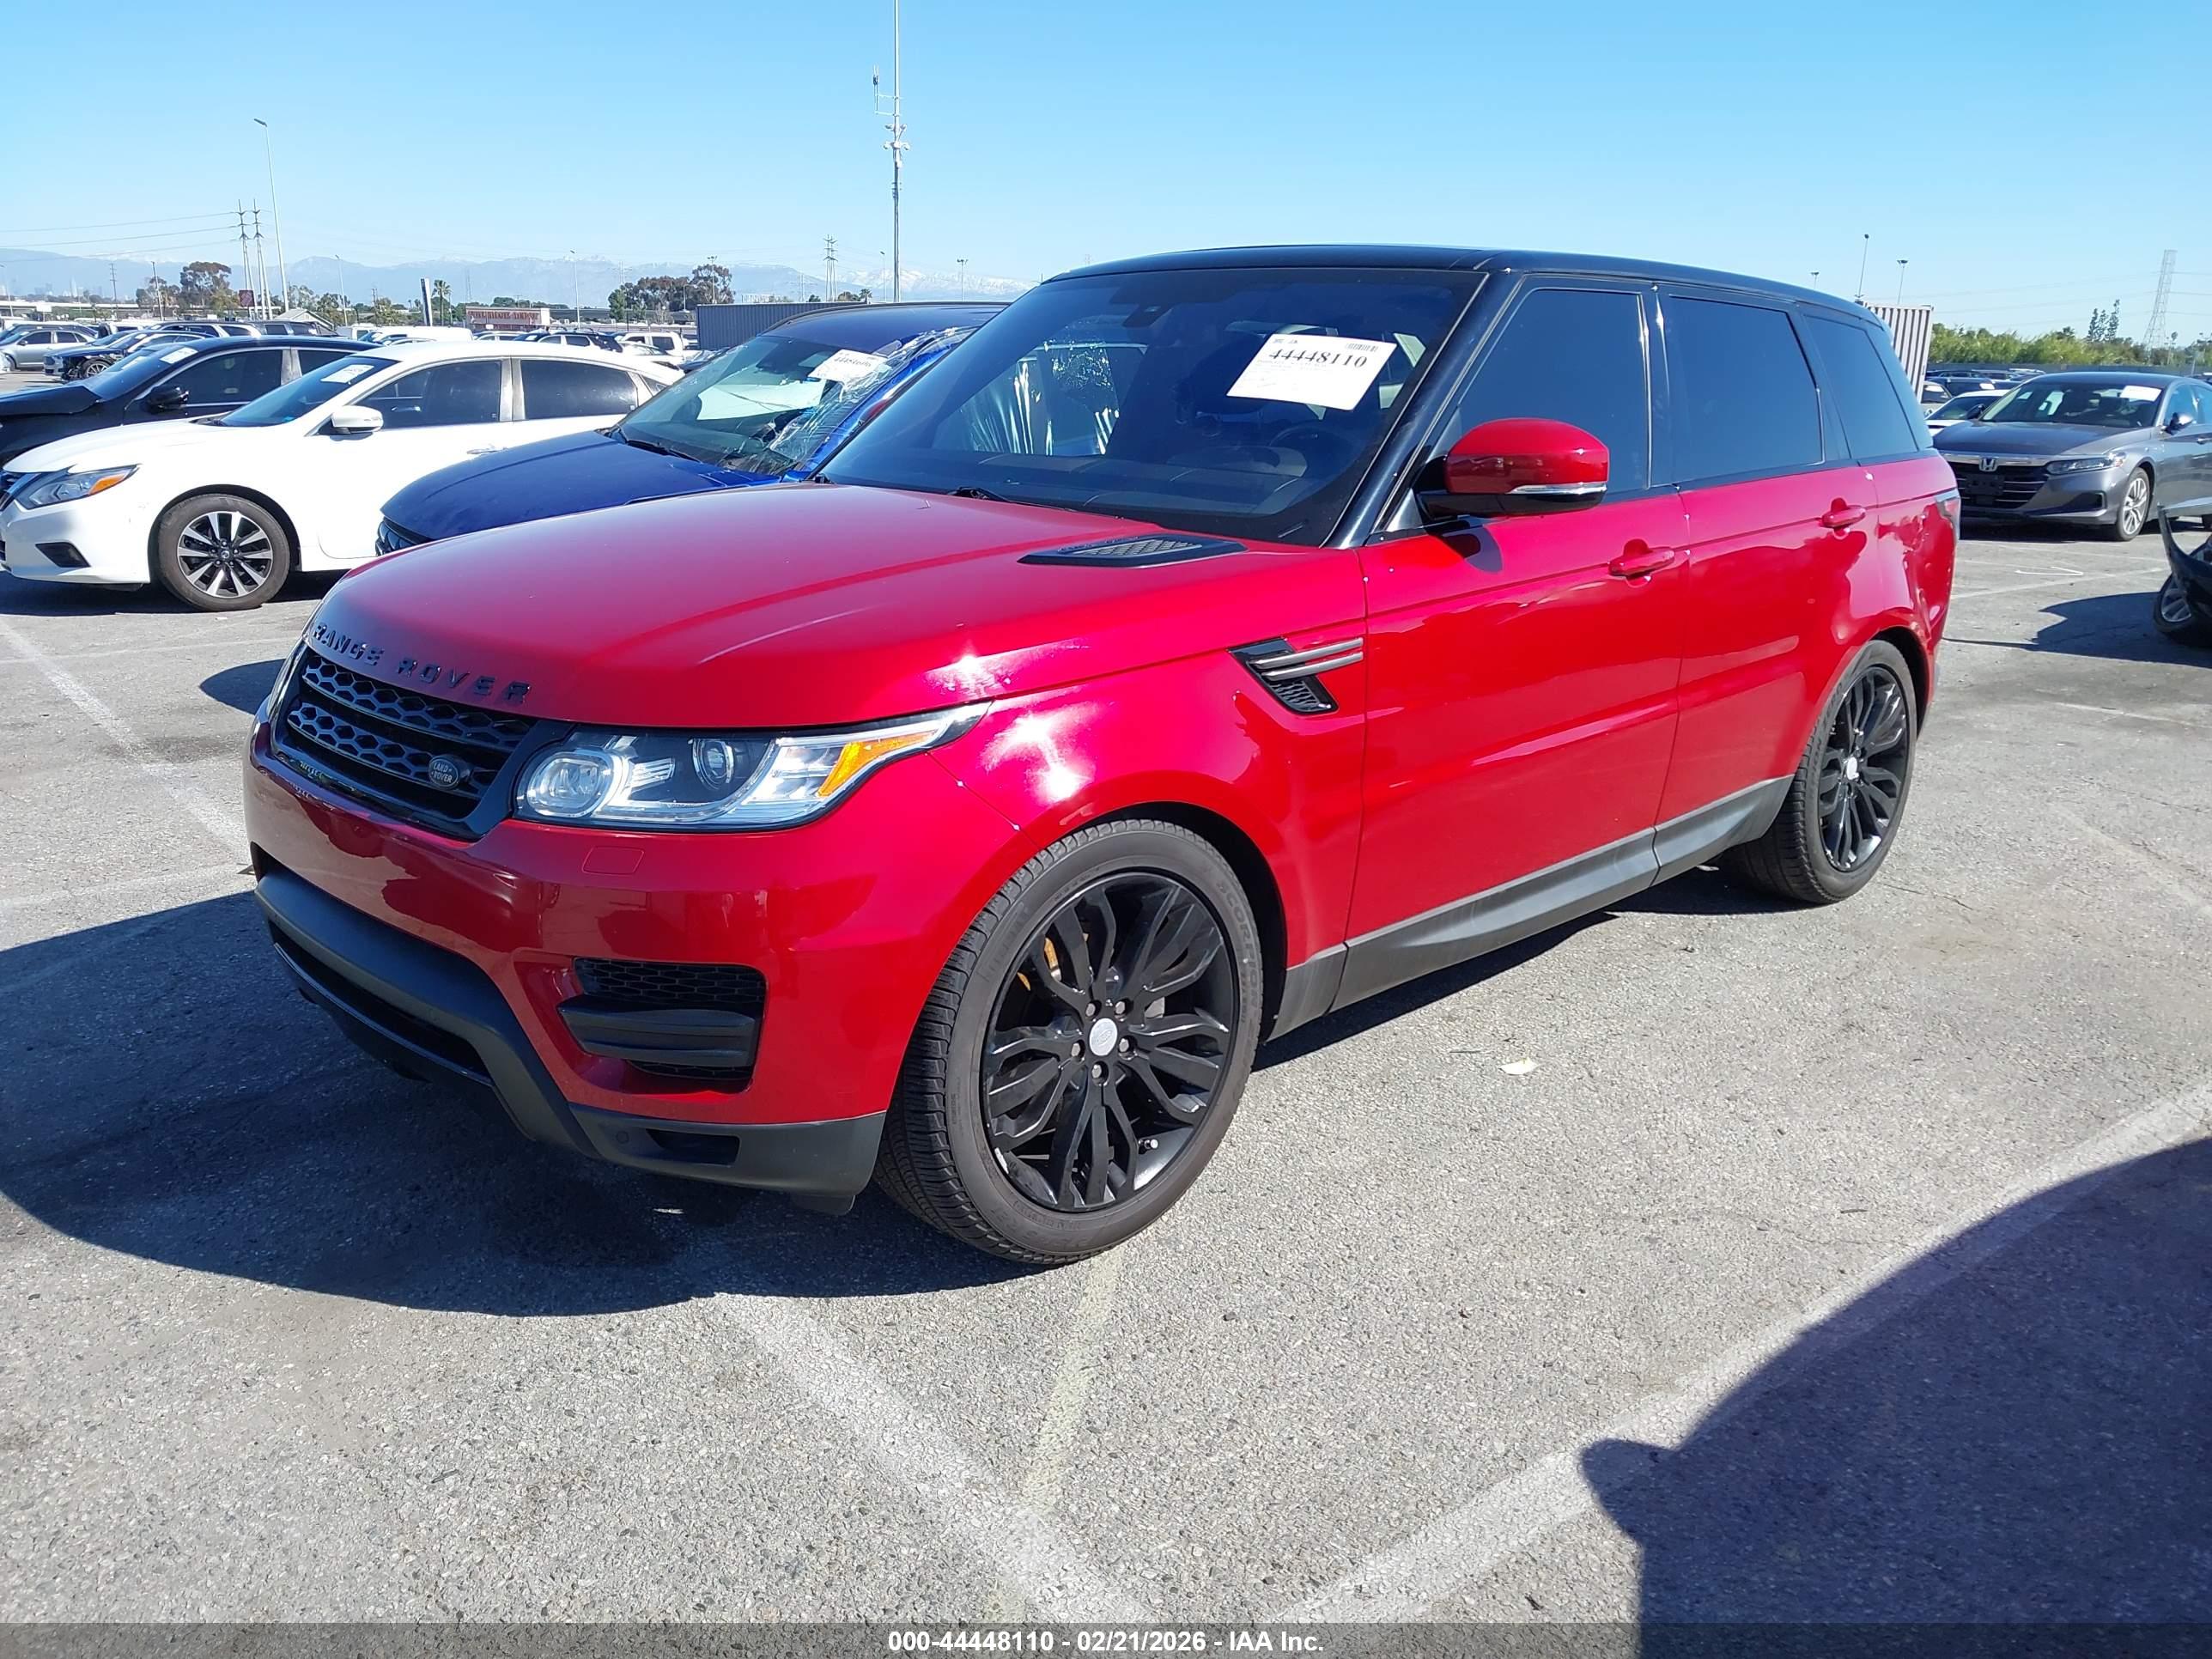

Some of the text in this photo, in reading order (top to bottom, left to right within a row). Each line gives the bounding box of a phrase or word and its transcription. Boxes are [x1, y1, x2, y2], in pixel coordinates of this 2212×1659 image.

[1268, 348, 1368, 369] 44448110
[313, 622, 532, 705] RANGE ROVER
